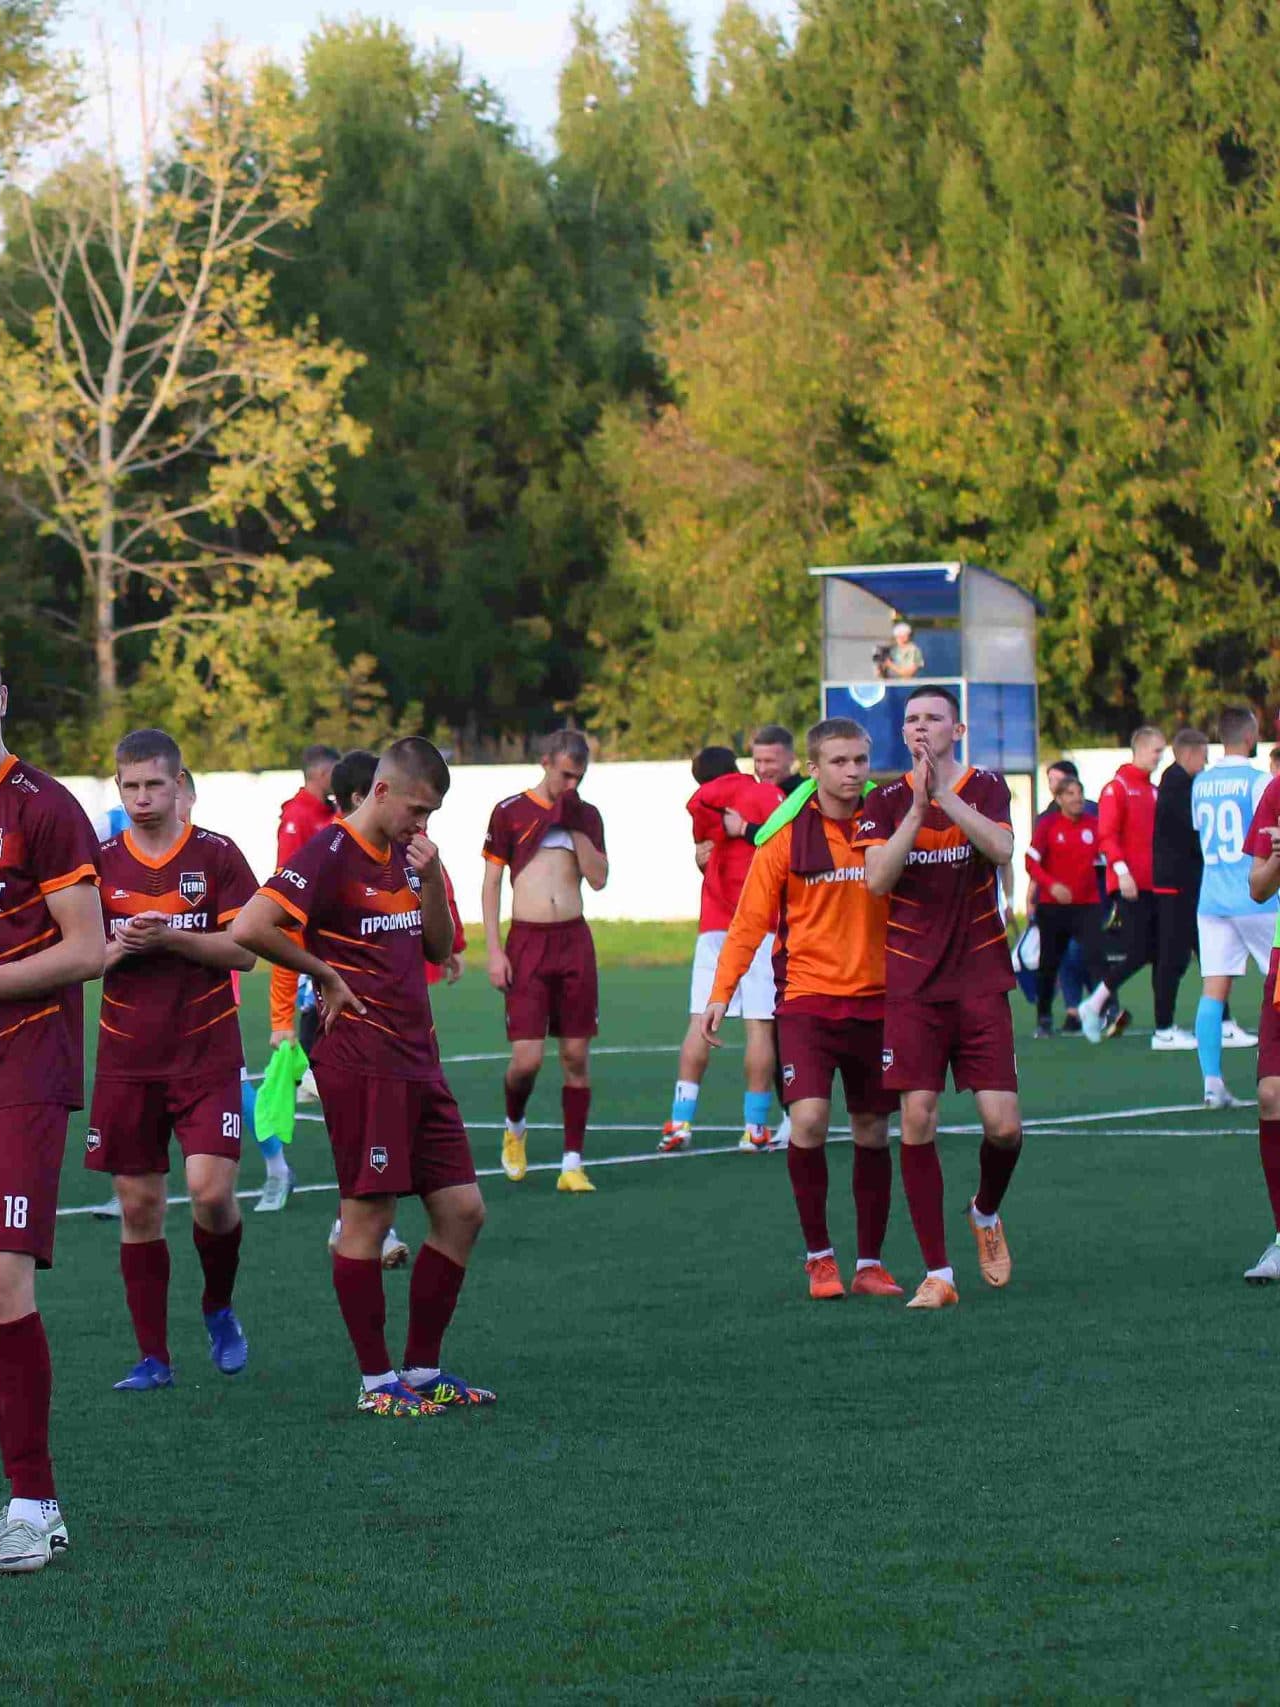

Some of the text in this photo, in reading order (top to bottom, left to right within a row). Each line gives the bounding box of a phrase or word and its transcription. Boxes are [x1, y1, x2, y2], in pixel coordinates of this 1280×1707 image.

[1197, 799, 1244, 865] 29
[182, 881, 205, 894] ТЕМП
[280, 869, 309, 890] ПСБ
[222, 1111, 240, 1139] 20
[4, 1195, 28, 1229] 18
